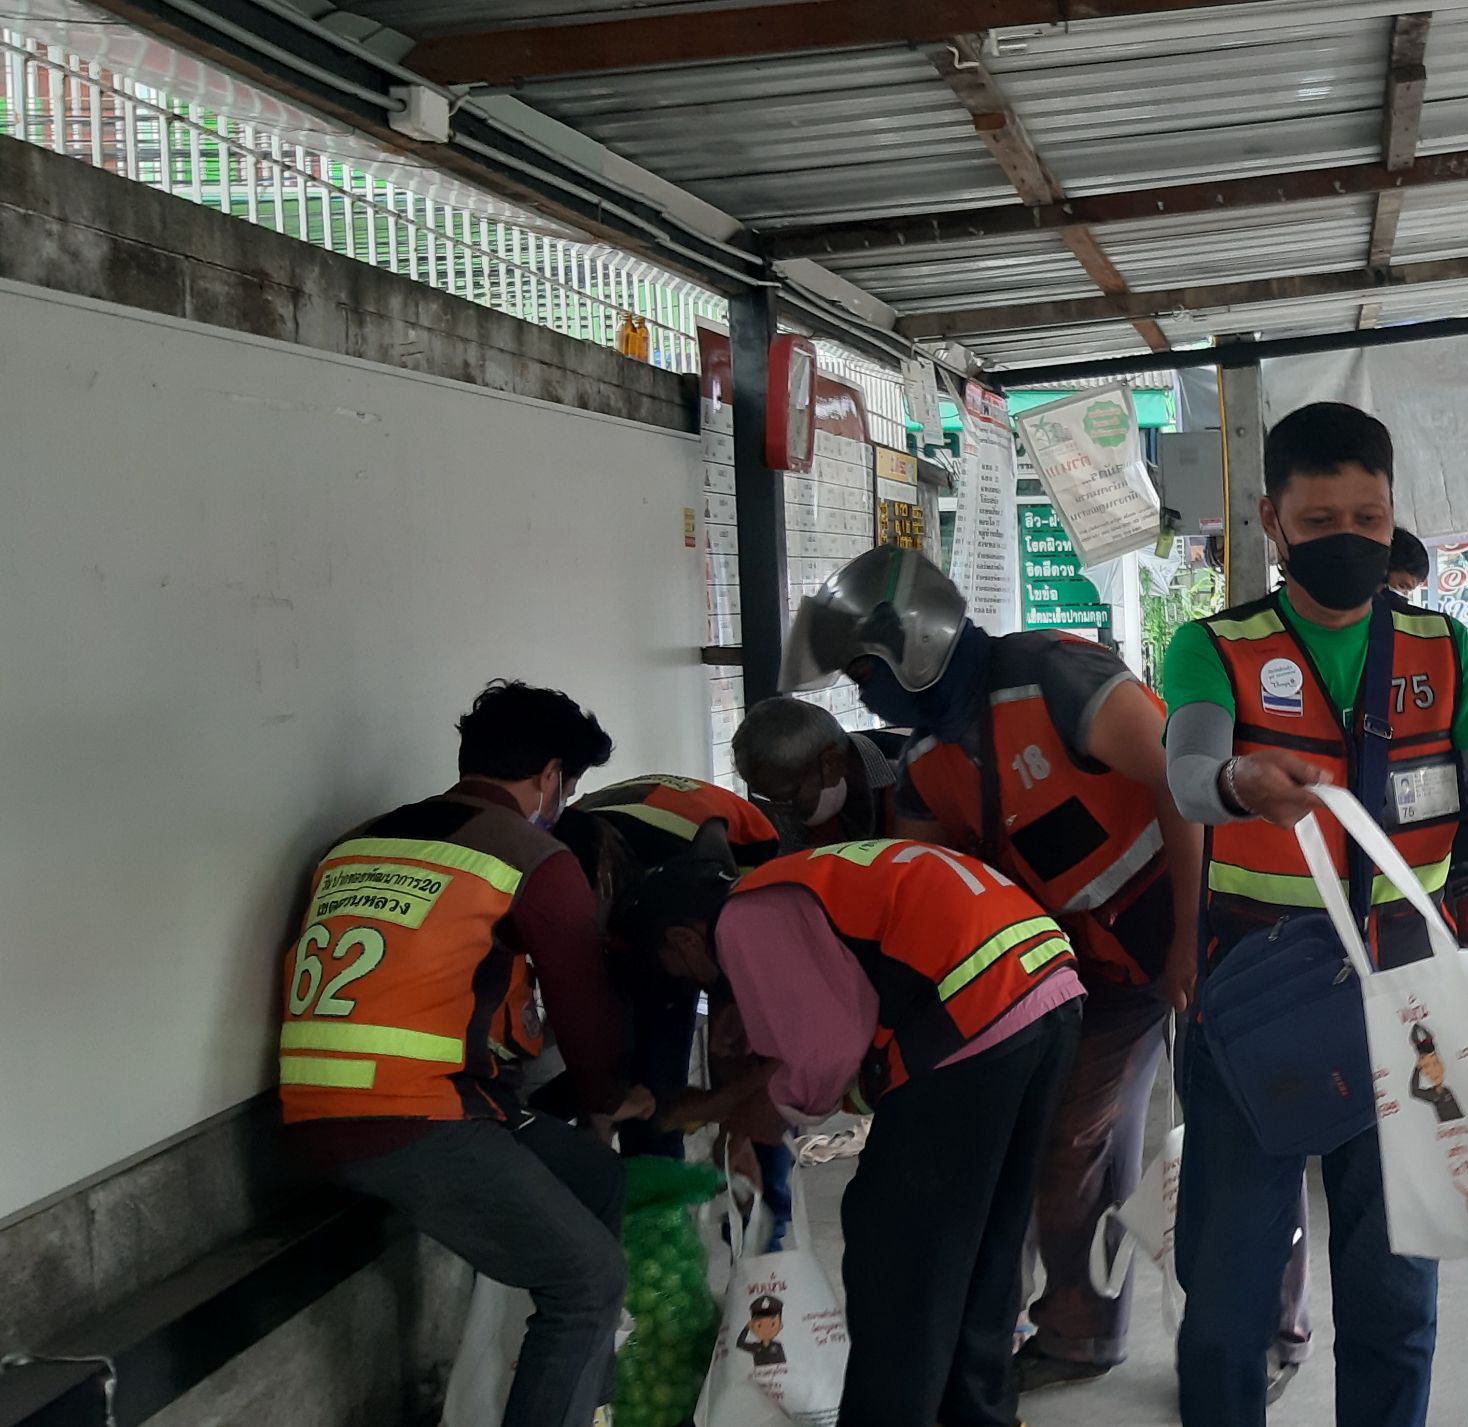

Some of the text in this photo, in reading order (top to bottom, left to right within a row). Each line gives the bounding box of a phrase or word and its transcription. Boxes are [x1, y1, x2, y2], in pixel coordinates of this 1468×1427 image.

[1025, 510, 1063, 528] สิว-ฝ้
[1391, 672, 1435, 713] 75
[1012, 744, 1050, 790] 18
[289, 923, 386, 1017] 62
